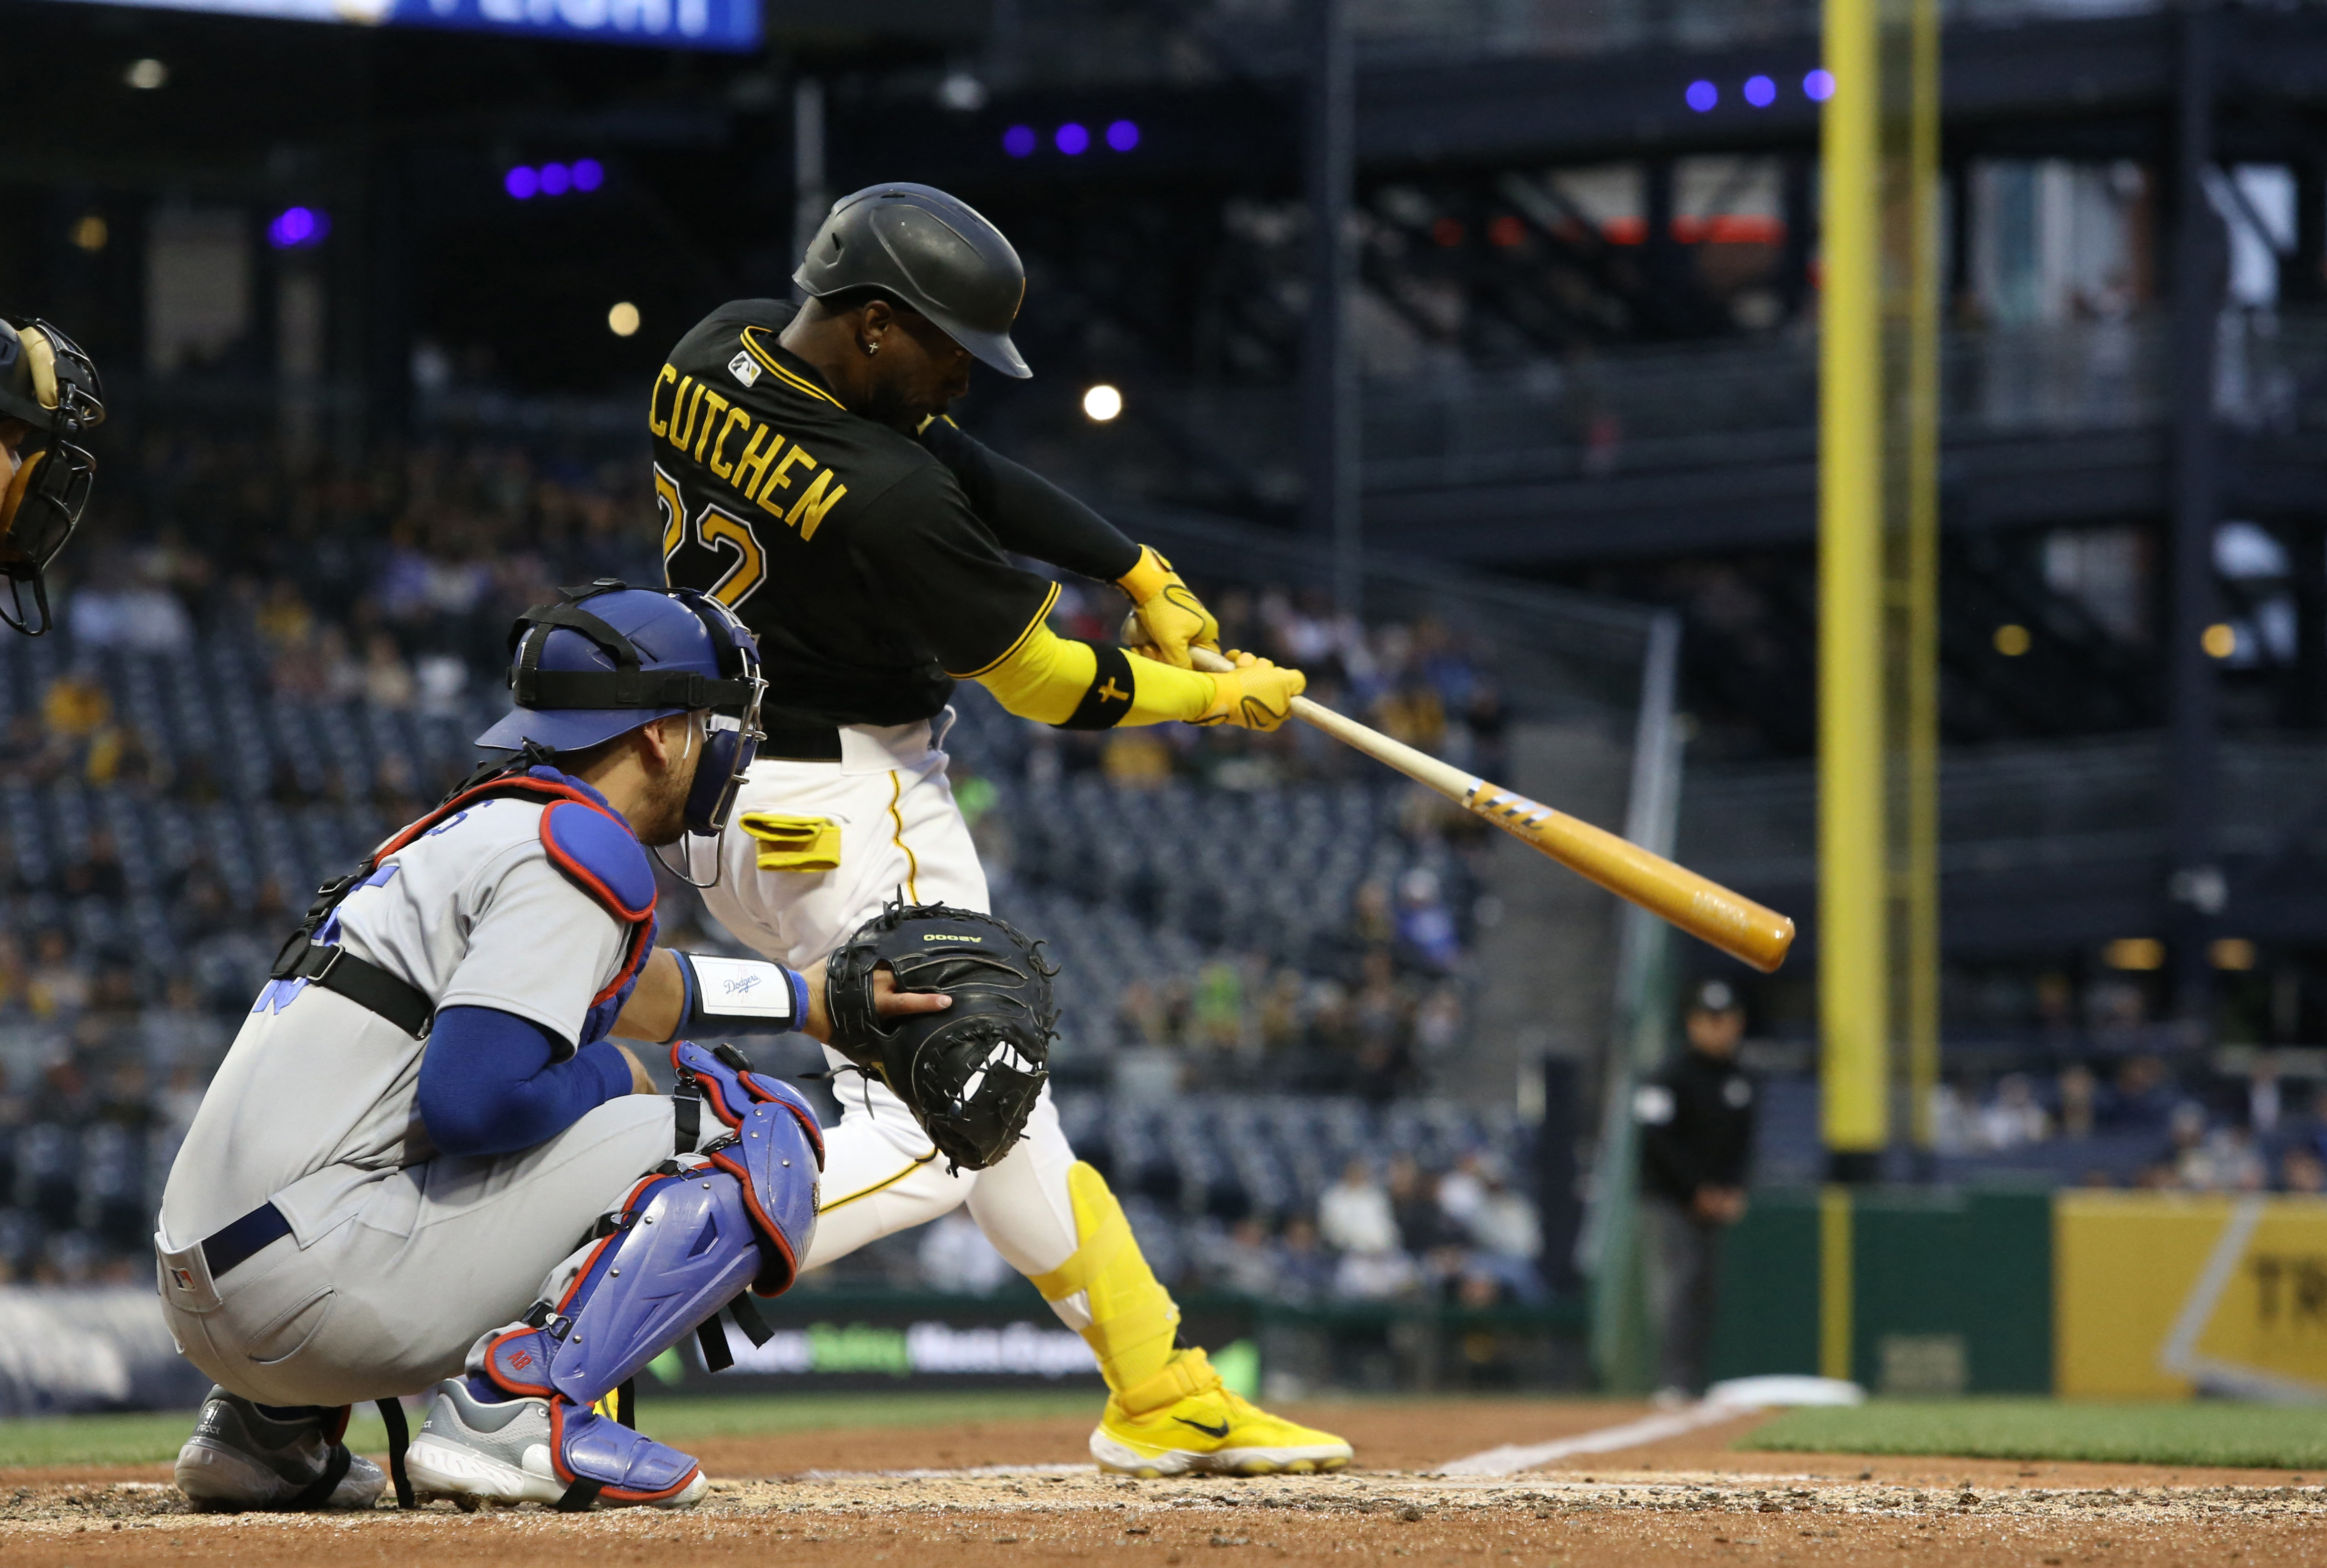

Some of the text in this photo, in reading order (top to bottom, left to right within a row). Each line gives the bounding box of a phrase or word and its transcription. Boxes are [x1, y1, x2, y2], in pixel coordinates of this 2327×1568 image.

[923, 934, 982, 943] A2000
[723, 974, 761, 994] Dodgers
[507, 1350, 532, 1370] AB
